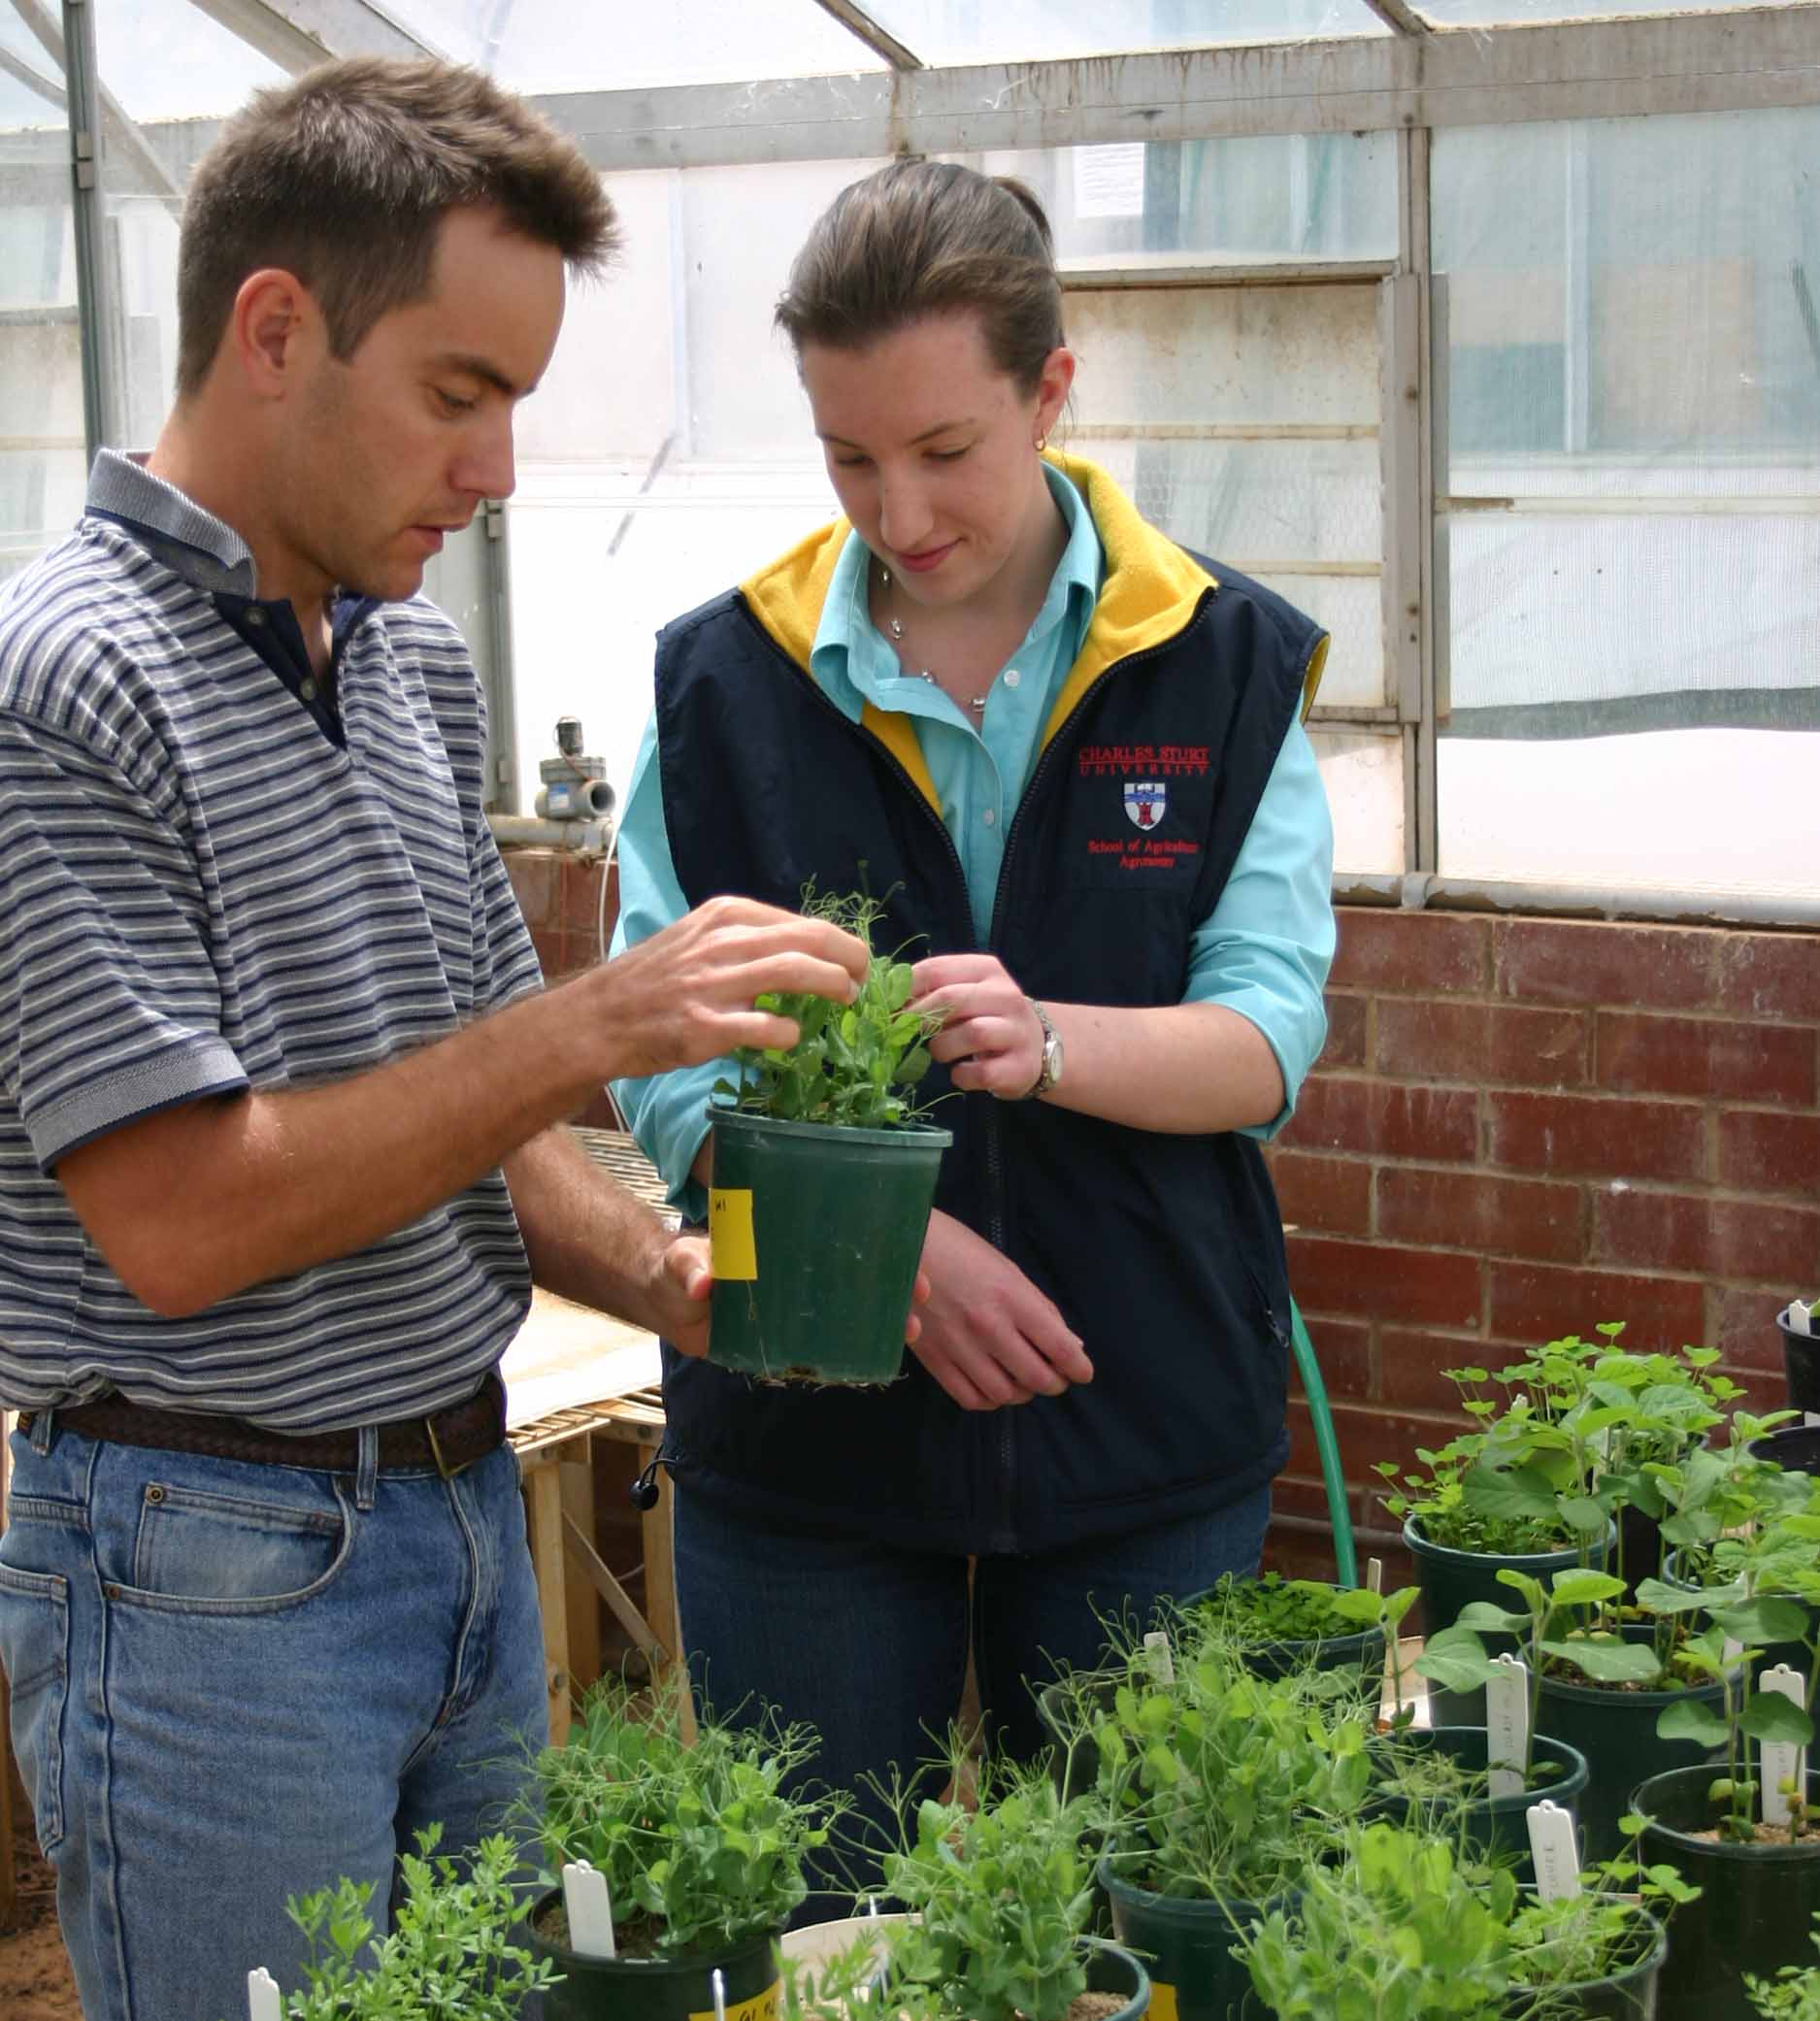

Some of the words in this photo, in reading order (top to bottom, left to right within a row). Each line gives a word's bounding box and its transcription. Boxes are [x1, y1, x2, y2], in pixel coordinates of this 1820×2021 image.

[1078, 745, 1154, 761] CHARLES
[1159, 745, 1209, 761] STURT
[1087, 839, 1124, 853] School
[1127, 839, 1142, 852] of
